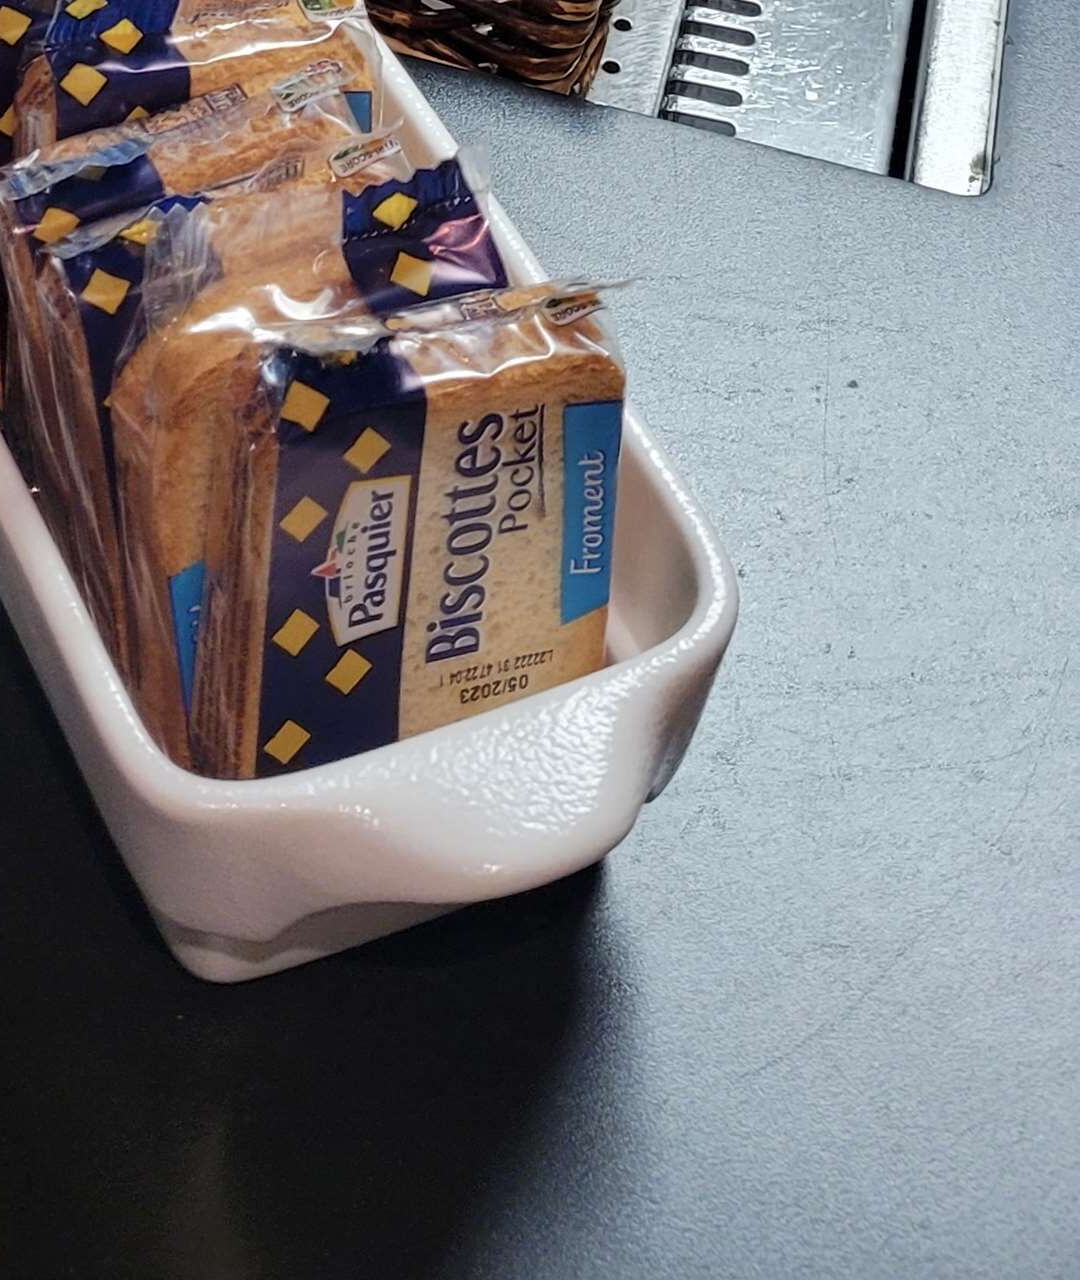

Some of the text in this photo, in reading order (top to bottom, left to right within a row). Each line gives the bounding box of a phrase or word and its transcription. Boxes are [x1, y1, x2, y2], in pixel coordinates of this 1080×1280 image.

[498, 403, 545, 536] Pocket
[568, 448, 608, 577] Froment
[348, 489, 398, 628] Pasquier
[424, 411, 506, 665] Biscottes
[459, 674, 529, 705] 05/2023
